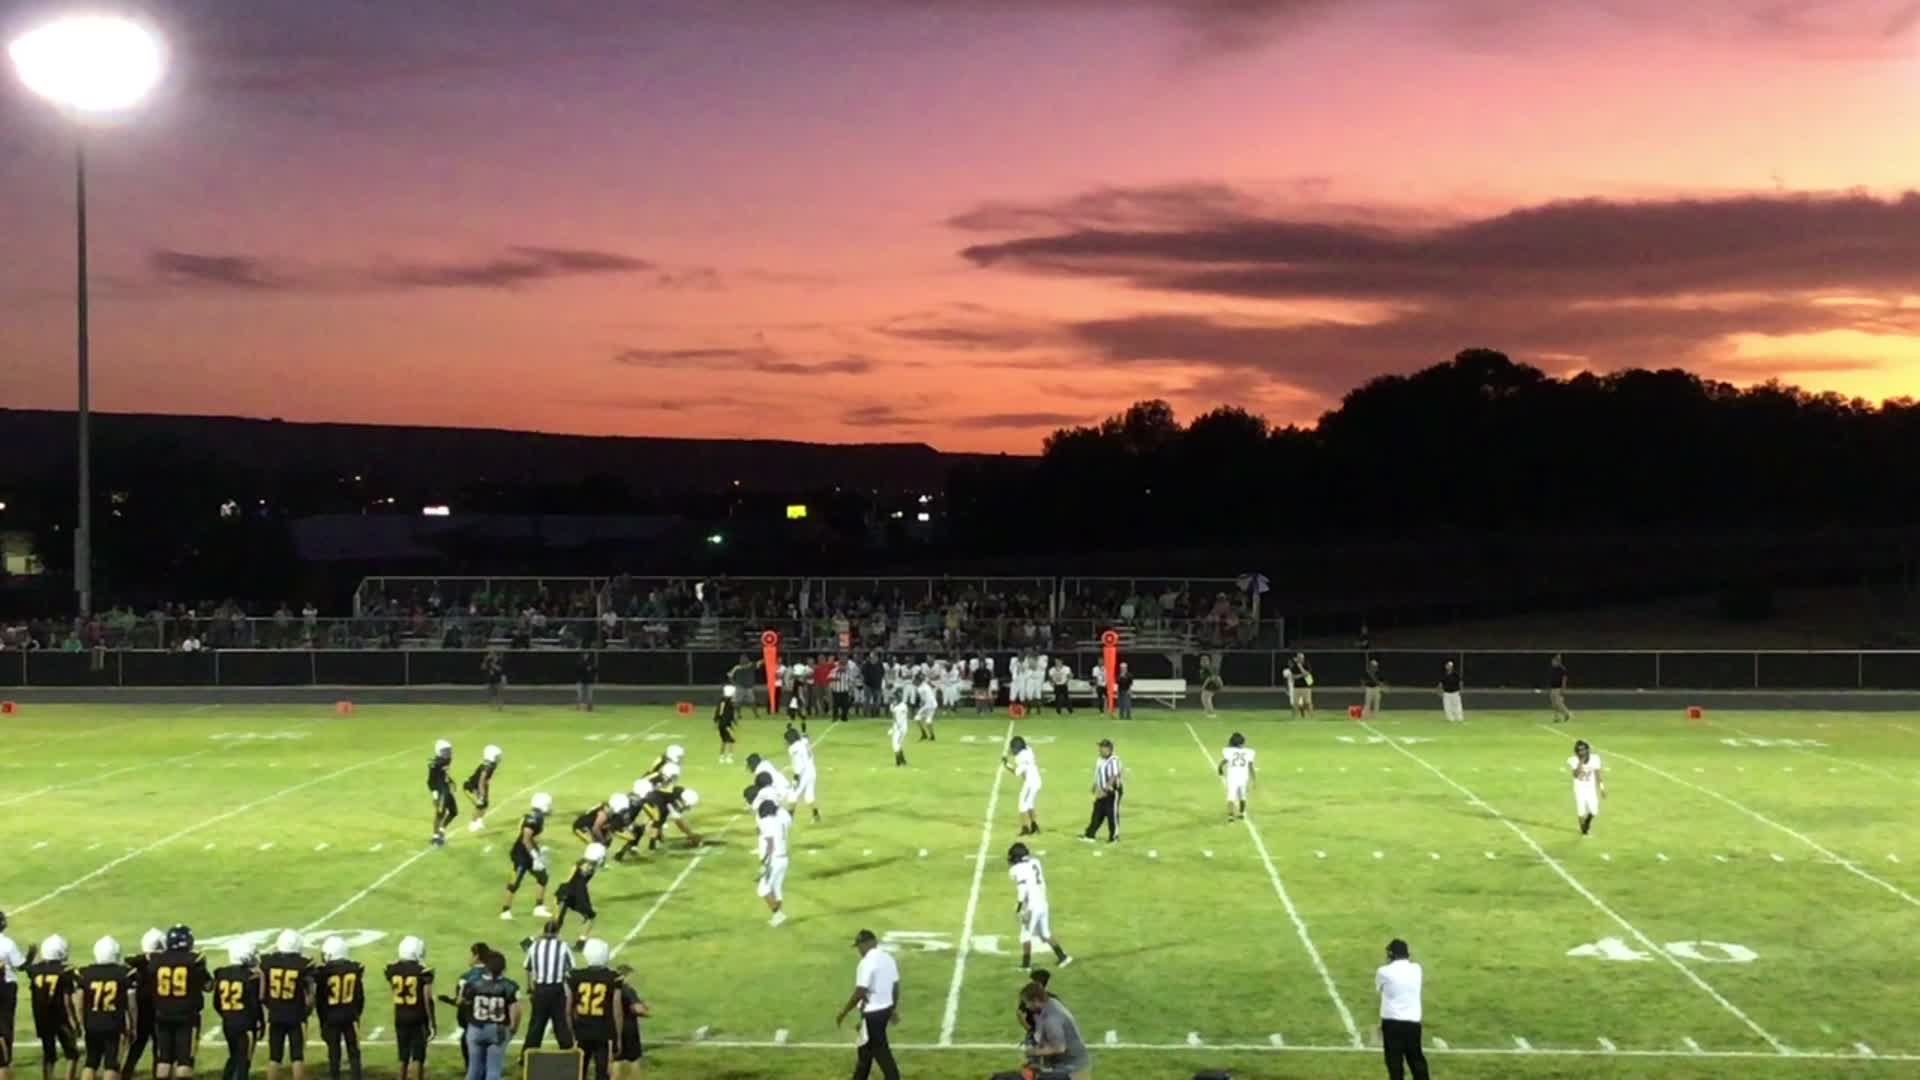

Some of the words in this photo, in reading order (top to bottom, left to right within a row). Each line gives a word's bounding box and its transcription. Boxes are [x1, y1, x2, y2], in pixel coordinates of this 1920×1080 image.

[1232, 751, 1248, 767] 25
[90, 981, 118, 1012] 72
[157, 966, 188, 996] 69
[219, 979, 245, 1011] 22
[269, 967, 299, 999] 55
[327, 973, 357, 1006] 30
[392, 974, 418, 1005] 23
[577, 981, 607, 1016] 32
